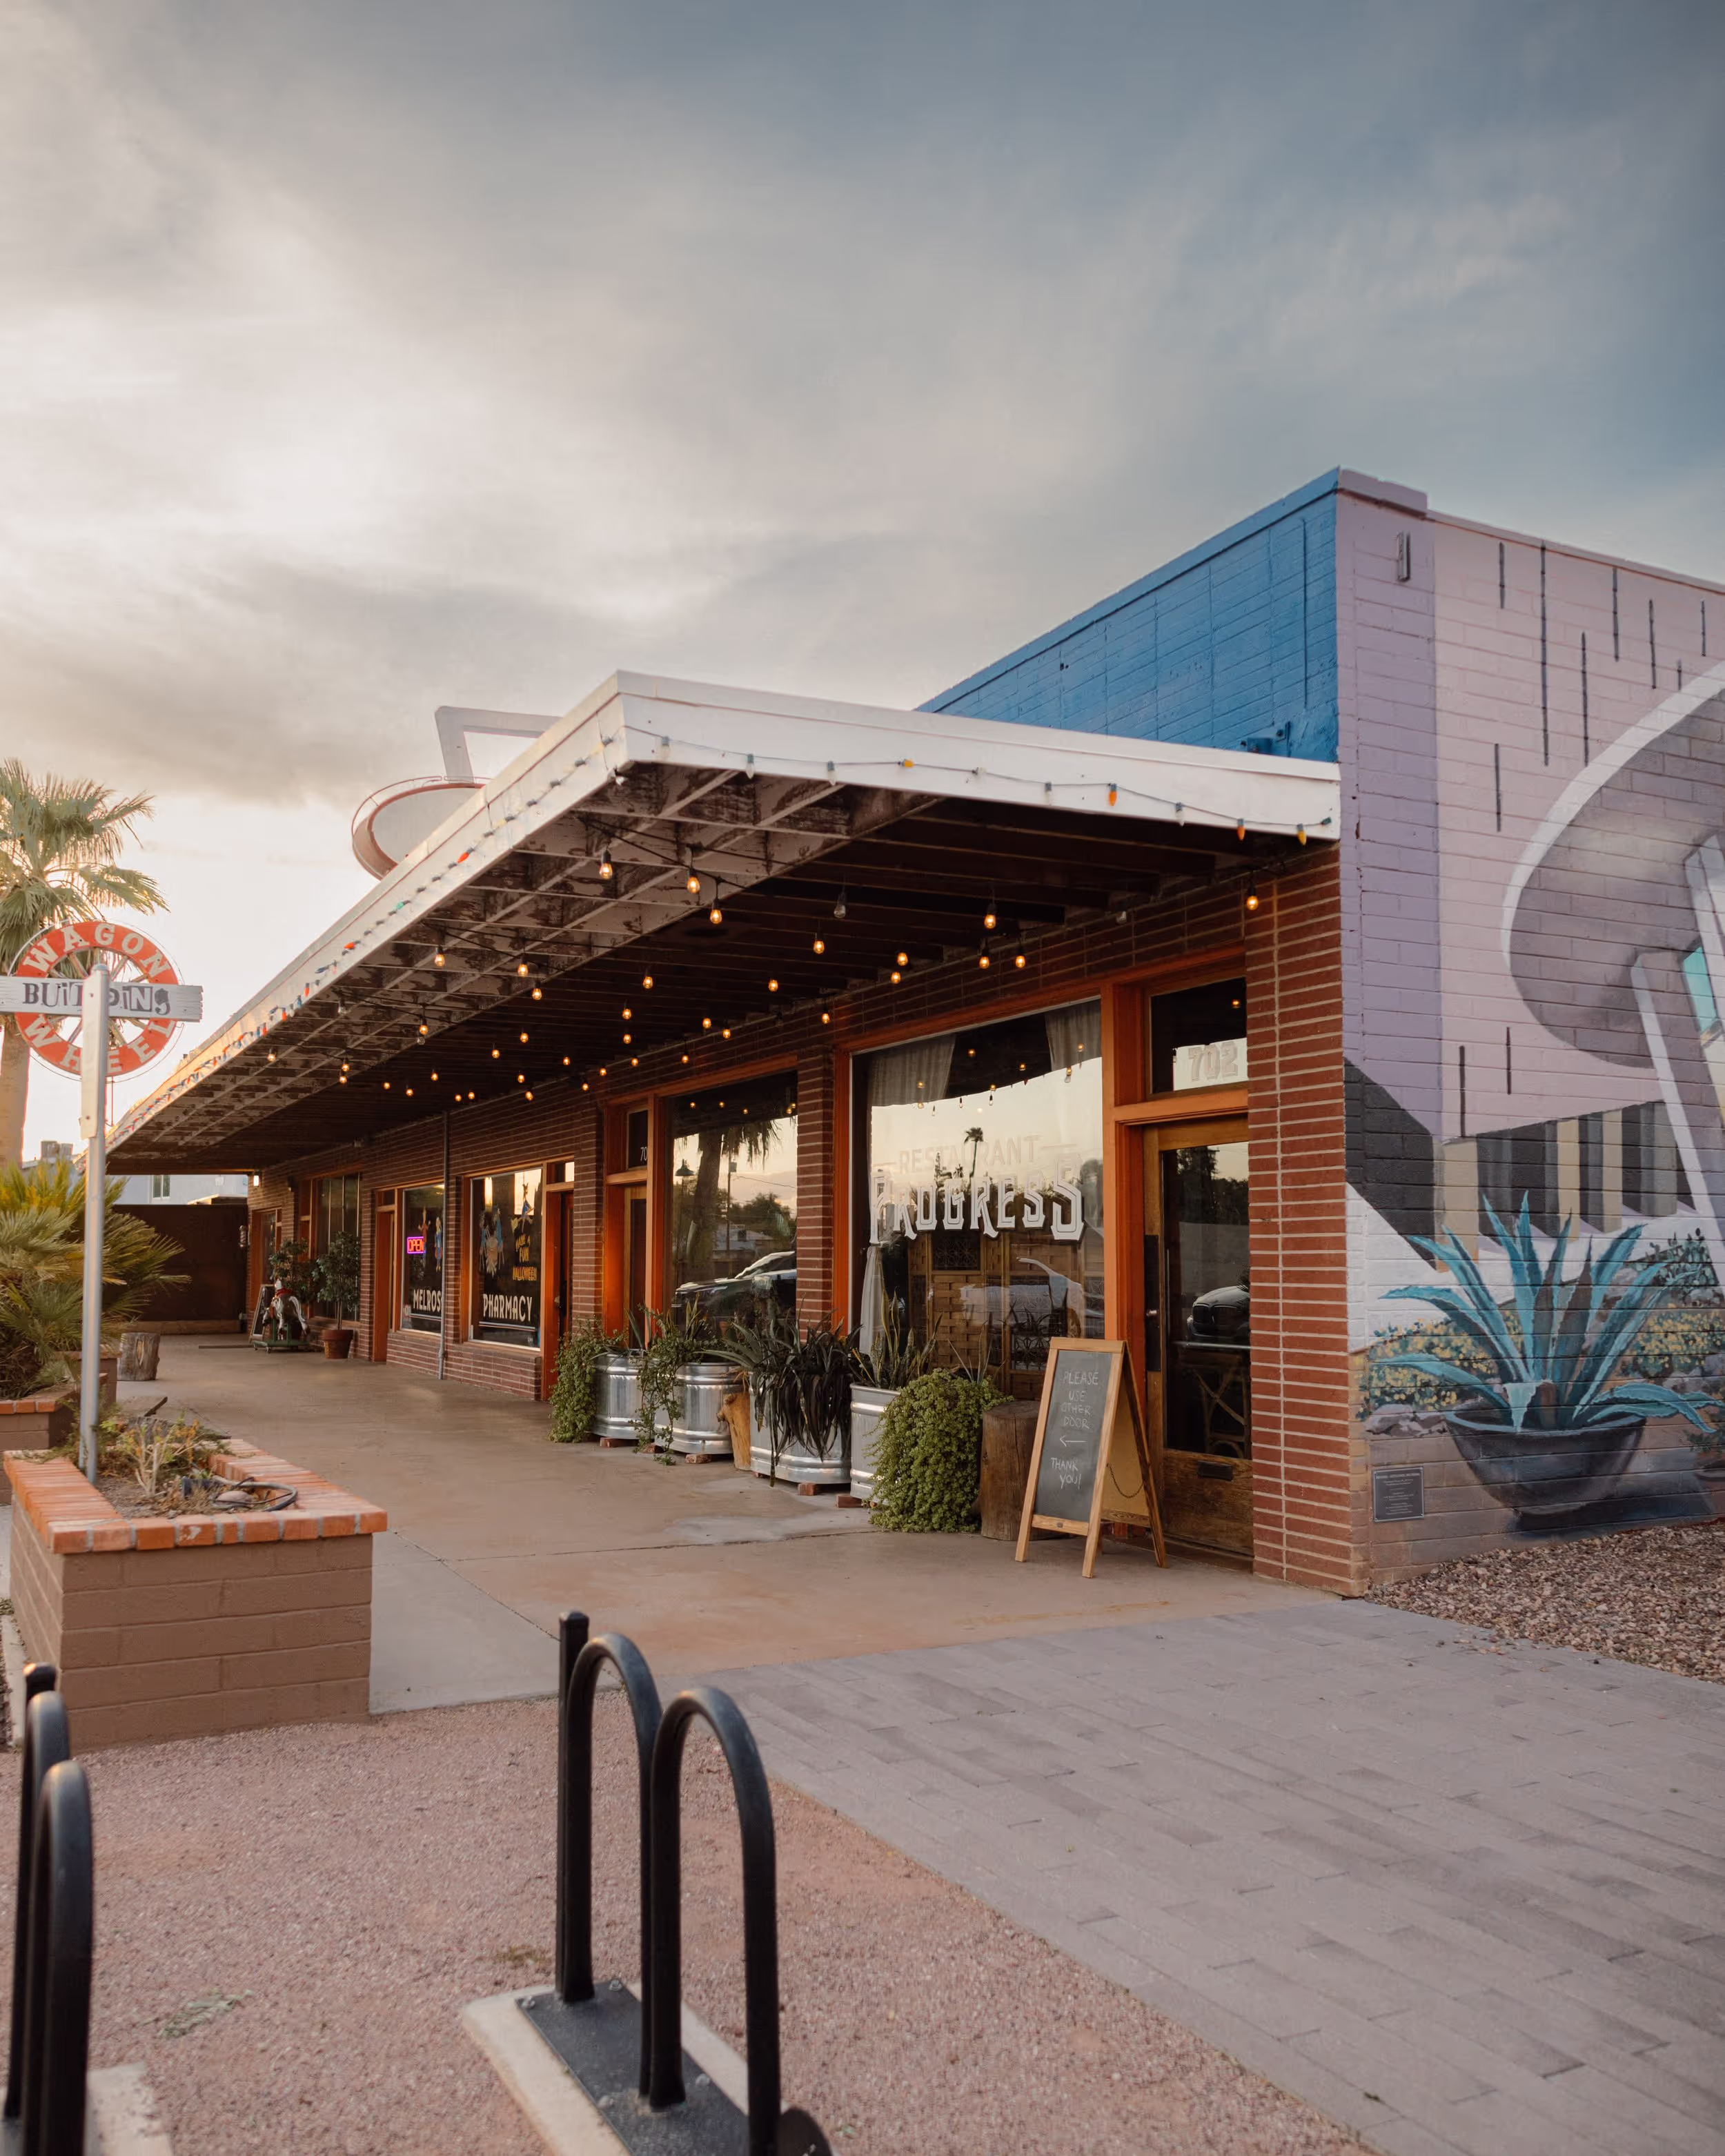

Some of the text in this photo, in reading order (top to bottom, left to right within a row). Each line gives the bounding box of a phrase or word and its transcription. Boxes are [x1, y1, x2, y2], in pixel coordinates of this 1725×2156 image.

[23, 922, 171, 978] WAGON
[1187, 1040, 1239, 1082] 702
[899, 1134, 1041, 1174] RESTAURANT
[869, 1154, 1085, 1245] PROGRESS
[513, 1266, 537, 1281] HALLOWEEN
[413, 1289, 442, 1312] MELROS
[483, 1294, 532, 1322] PHARMACY
[1063, 1370, 1098, 1385] PLEASE
[1069, 1390, 1085, 1402] USE
[1061, 1403, 1090, 1416] OTHER
[1063, 1416, 1090, 1430] DOOR
[1050, 1457, 1078, 1472] THANK
[1059, 1473, 1081, 1490] YOU!
